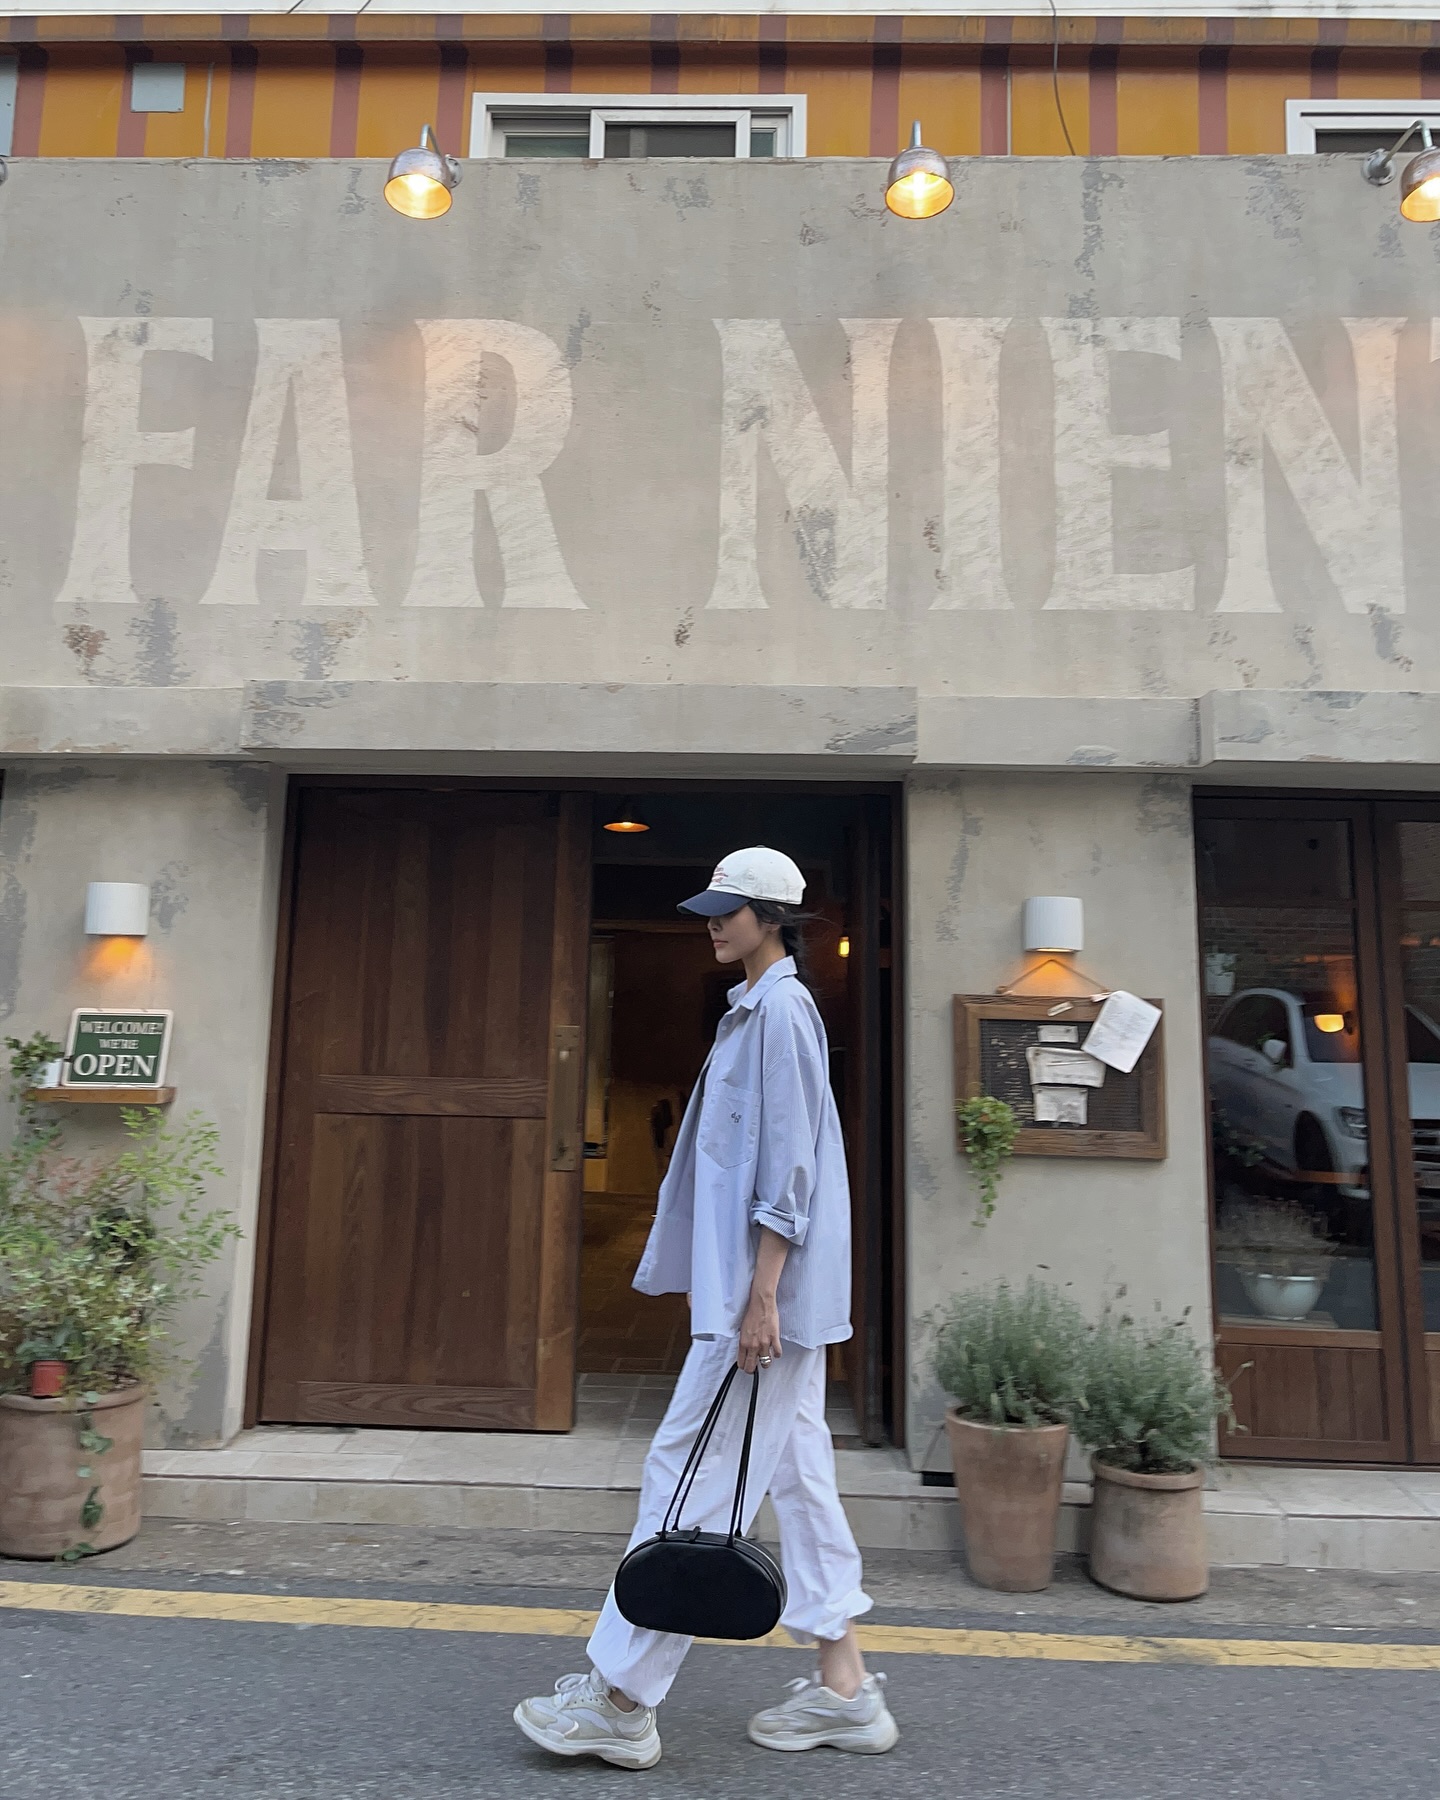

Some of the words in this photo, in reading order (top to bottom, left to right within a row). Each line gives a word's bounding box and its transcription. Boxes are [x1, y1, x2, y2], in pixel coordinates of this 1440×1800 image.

[54, 316, 590, 610] FAR
[704, 317, 1440, 614] NIEN
[73, 1053, 158, 1077] OPEN
